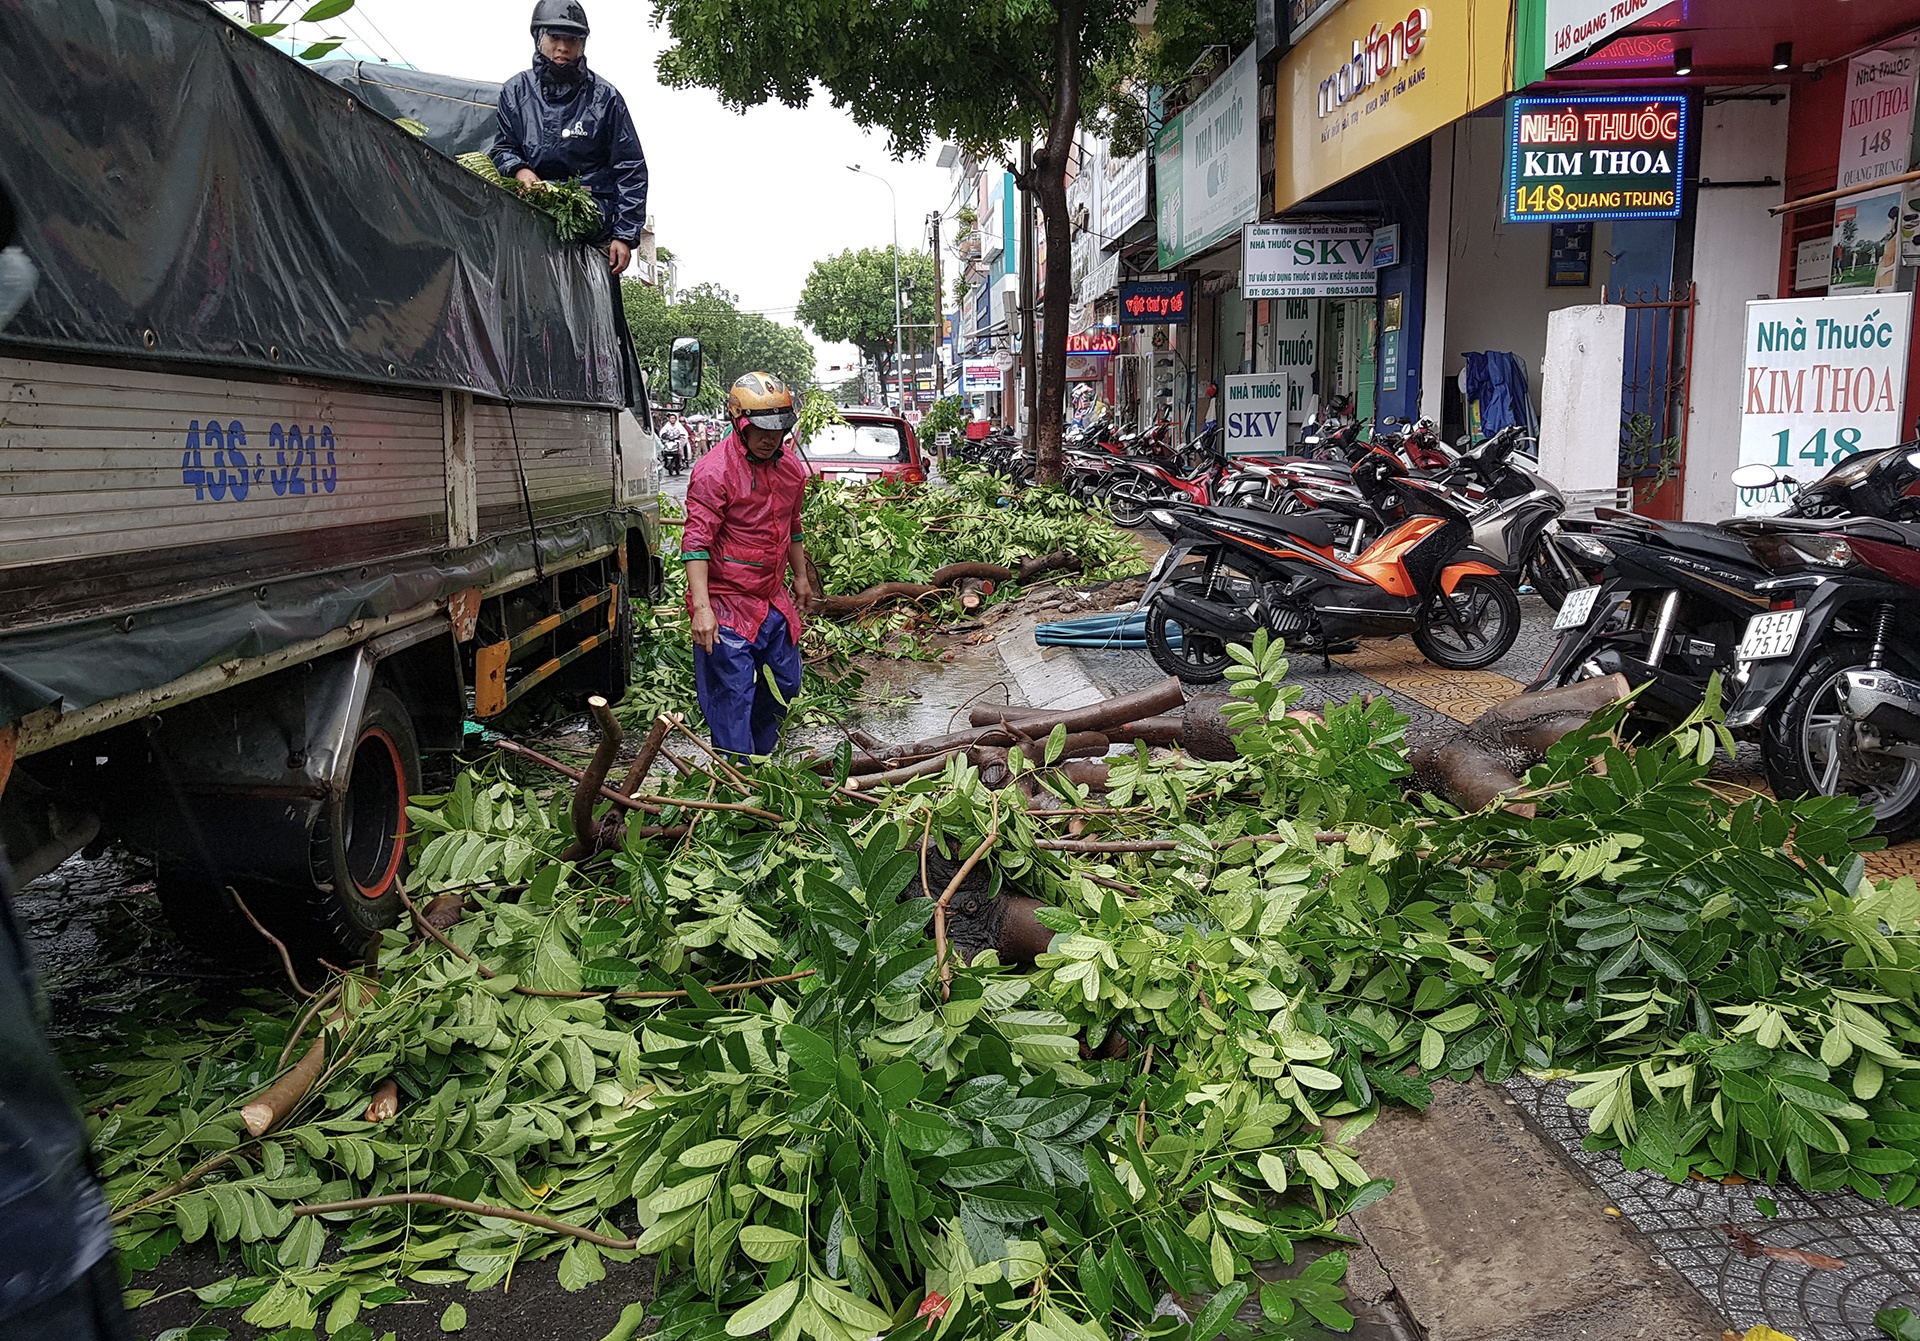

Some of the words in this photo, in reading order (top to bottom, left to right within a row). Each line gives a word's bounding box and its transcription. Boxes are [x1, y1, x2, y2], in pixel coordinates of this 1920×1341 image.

[1554, 24, 1571, 55] 148
[1573, 13, 1607, 44] QUANG
[1610, 0, 1648, 23] TRUNG
[1318, 7, 1427, 118] mobifone
[1848, 95, 1875, 129] KIM
[1875, 85, 1910, 121] THOA
[1520, 107, 1579, 143] NHÀ
[1584, 103, 1678, 141] THUỐC
[1859, 128, 1892, 158] 148
[1523, 151, 1583, 177] KIM
[1590, 149, 1672, 175] THOA
[1843, 165, 1872, 187] QUANG
[1873, 157, 1903, 178] TRUNG
[1516, 184, 1565, 212] 148
[1566, 192, 1621, 211] QUANG
[1623, 190, 1675, 207] TRUNG
[1249, 239, 1266, 249] NHÀ
[1268, 237, 1292, 249] THUỐC
[1271, 228, 1279, 236] TY
[1293, 239, 1374, 266] SKV
[1261, 288, 1286, 296] 0236.3
[1287, 287, 1316, 296] 701.800
[1326, 286, 1374, 295] 0903.549.000
[1757, 317, 1807, 352] Nhà
[1816, 308, 1893, 349] Thuốc
[1278, 330, 1314, 366] THUỐC
[1230, 382, 1249, 400] NHÀ
[1251, 379, 1281, 399] THUỐC
[1745, 366, 1806, 414] KIM
[1812, 364, 1895, 414] THOA
[1228, 412, 1282, 438] SKV
[182, 420, 249, 501] 43S
[269, 422, 337, 496] 3213
[1771, 427, 1862, 467] 148
[1755, 613, 1793, 636] 43-E1
[1743, 634, 1793, 657] 475.12
